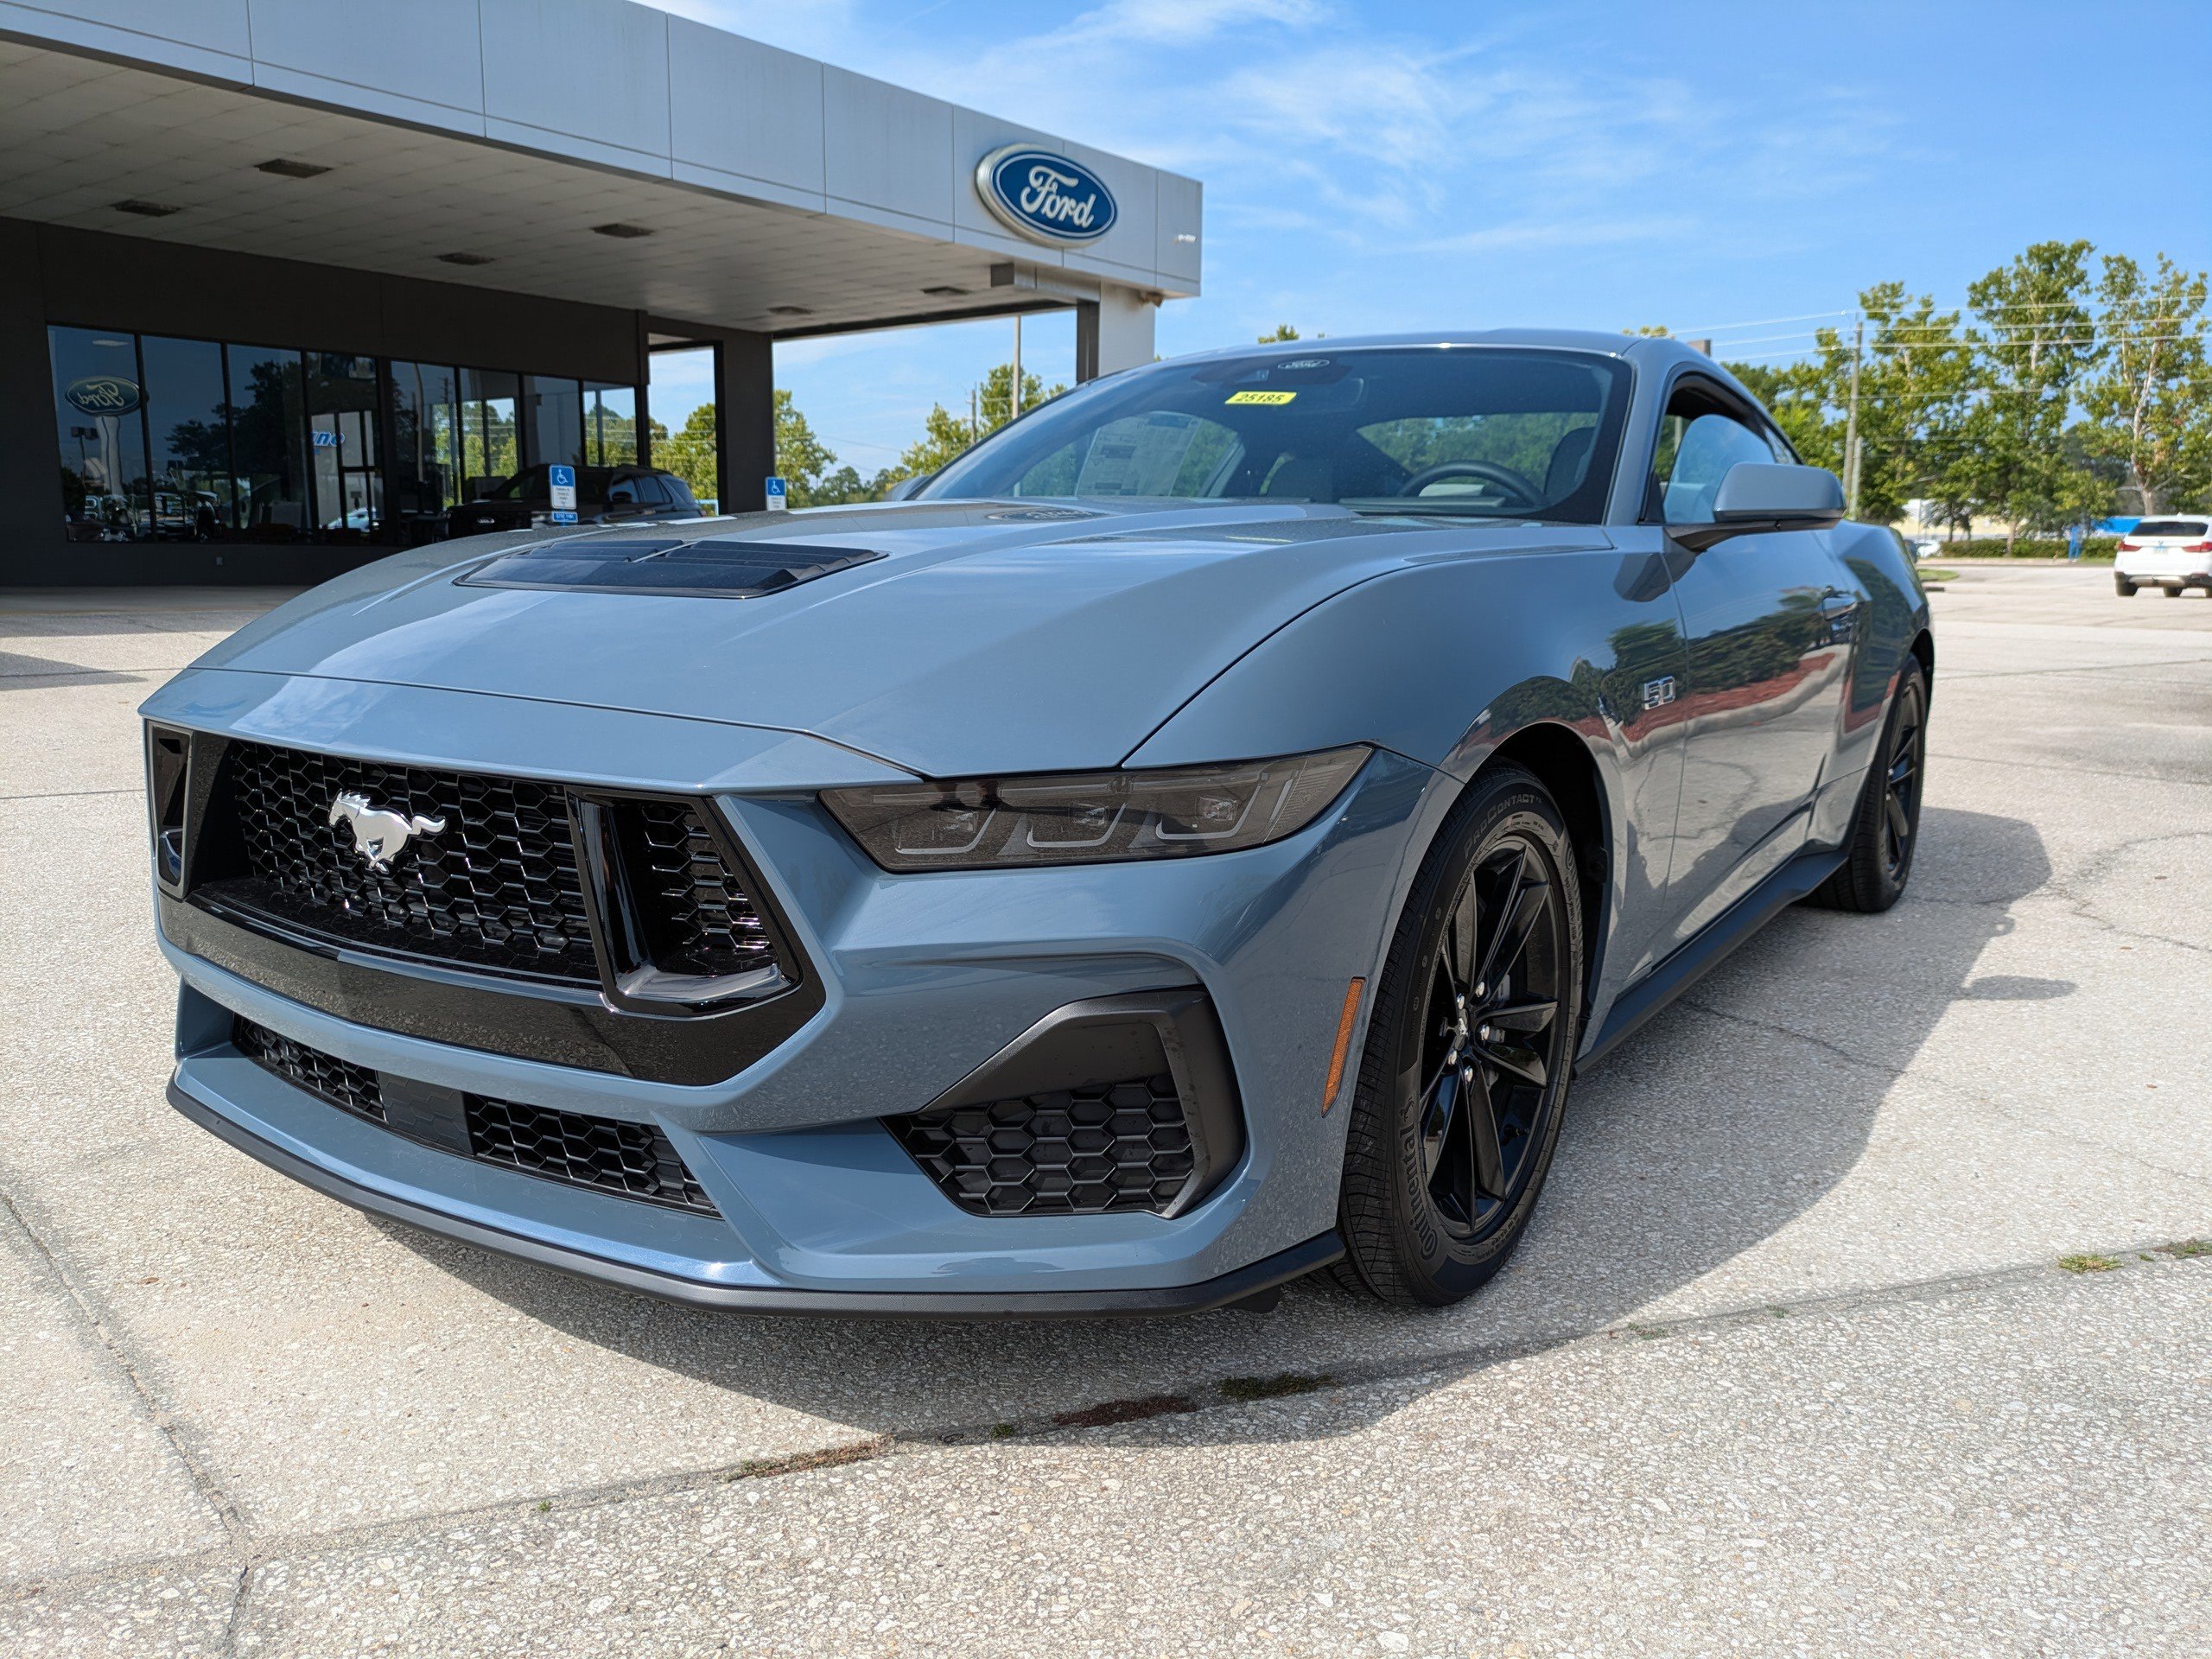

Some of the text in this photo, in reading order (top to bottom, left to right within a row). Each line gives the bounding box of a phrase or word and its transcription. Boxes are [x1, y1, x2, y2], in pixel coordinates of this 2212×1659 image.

[1020, 165, 1096, 229] Ford
[1235, 393, 1286, 403] 25185
[1399, 1124, 1439, 1261] Continental
